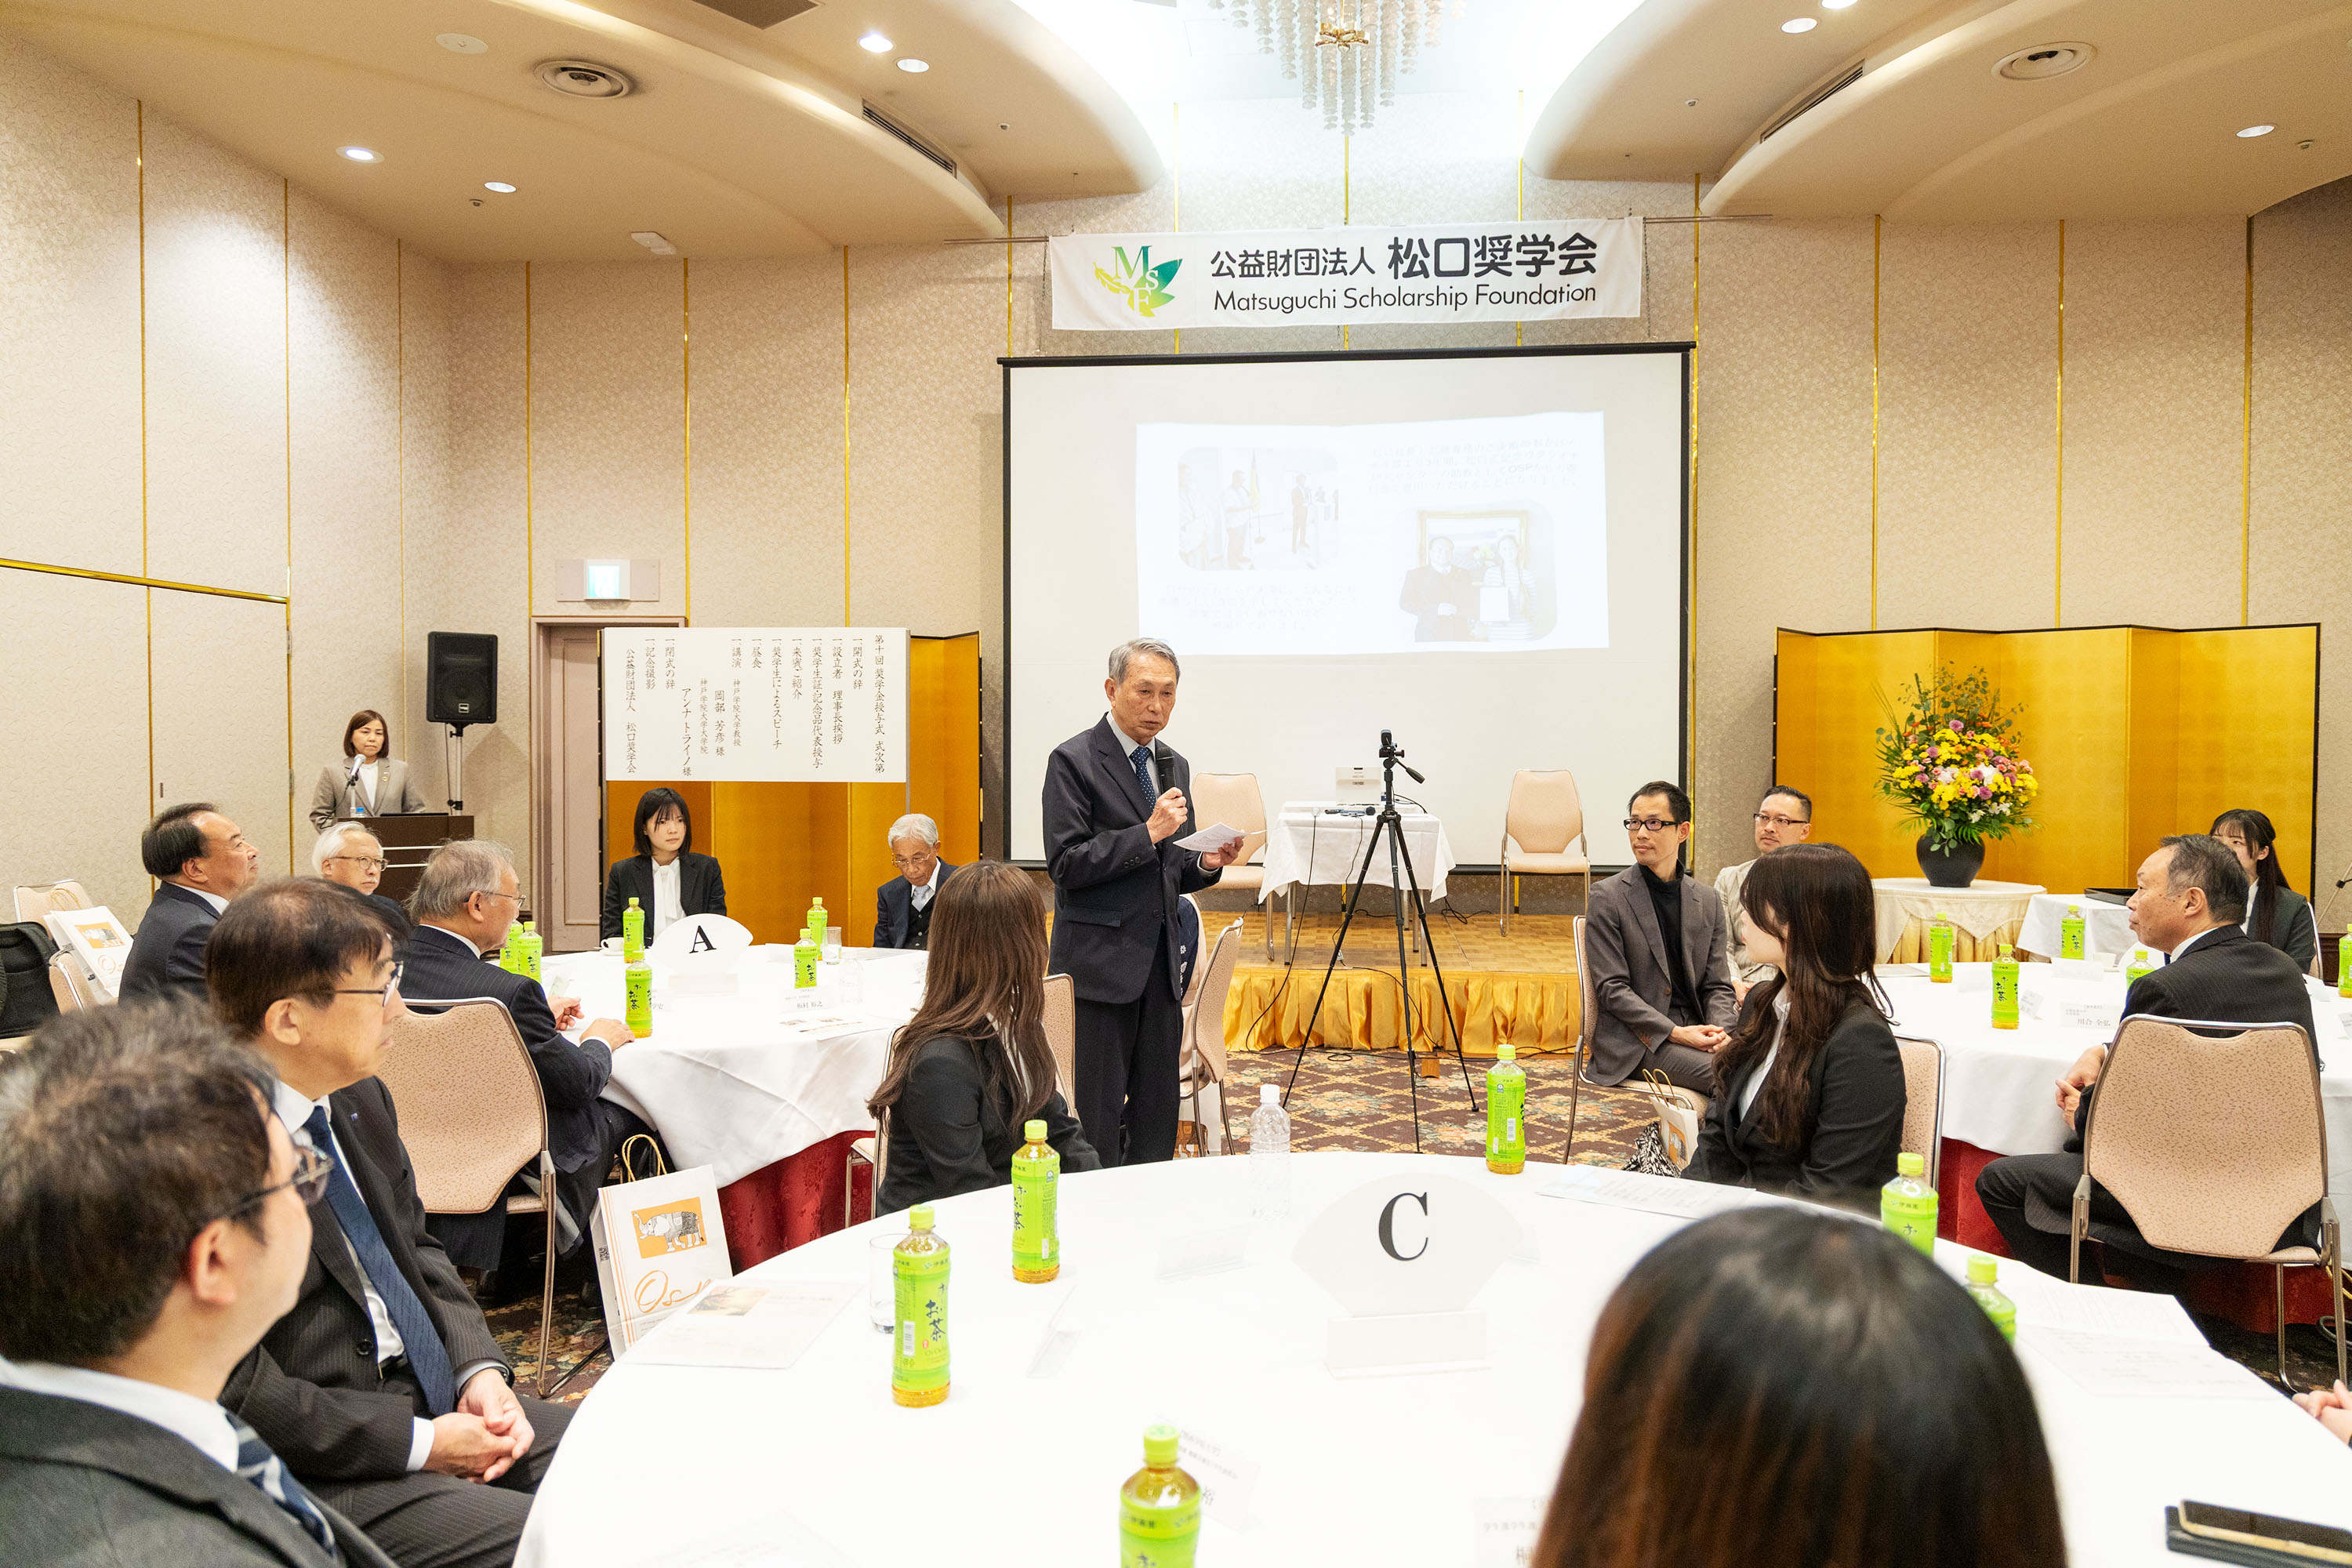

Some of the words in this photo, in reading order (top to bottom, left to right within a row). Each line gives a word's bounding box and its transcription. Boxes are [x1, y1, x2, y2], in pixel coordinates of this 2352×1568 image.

[1211, 247, 1375, 278] 公益財団法人
[1388, 233, 1597, 279] 松口奨学会
[1215, 289, 1335, 314] Matsuguchi
[1345, 285, 1467, 310] Scholarship
[1476, 284, 1595, 304] Foundation
[832, 690, 844, 744] 理事長挨拶
[689, 925, 717, 953] A
[1378, 1192, 1428, 1261] C
